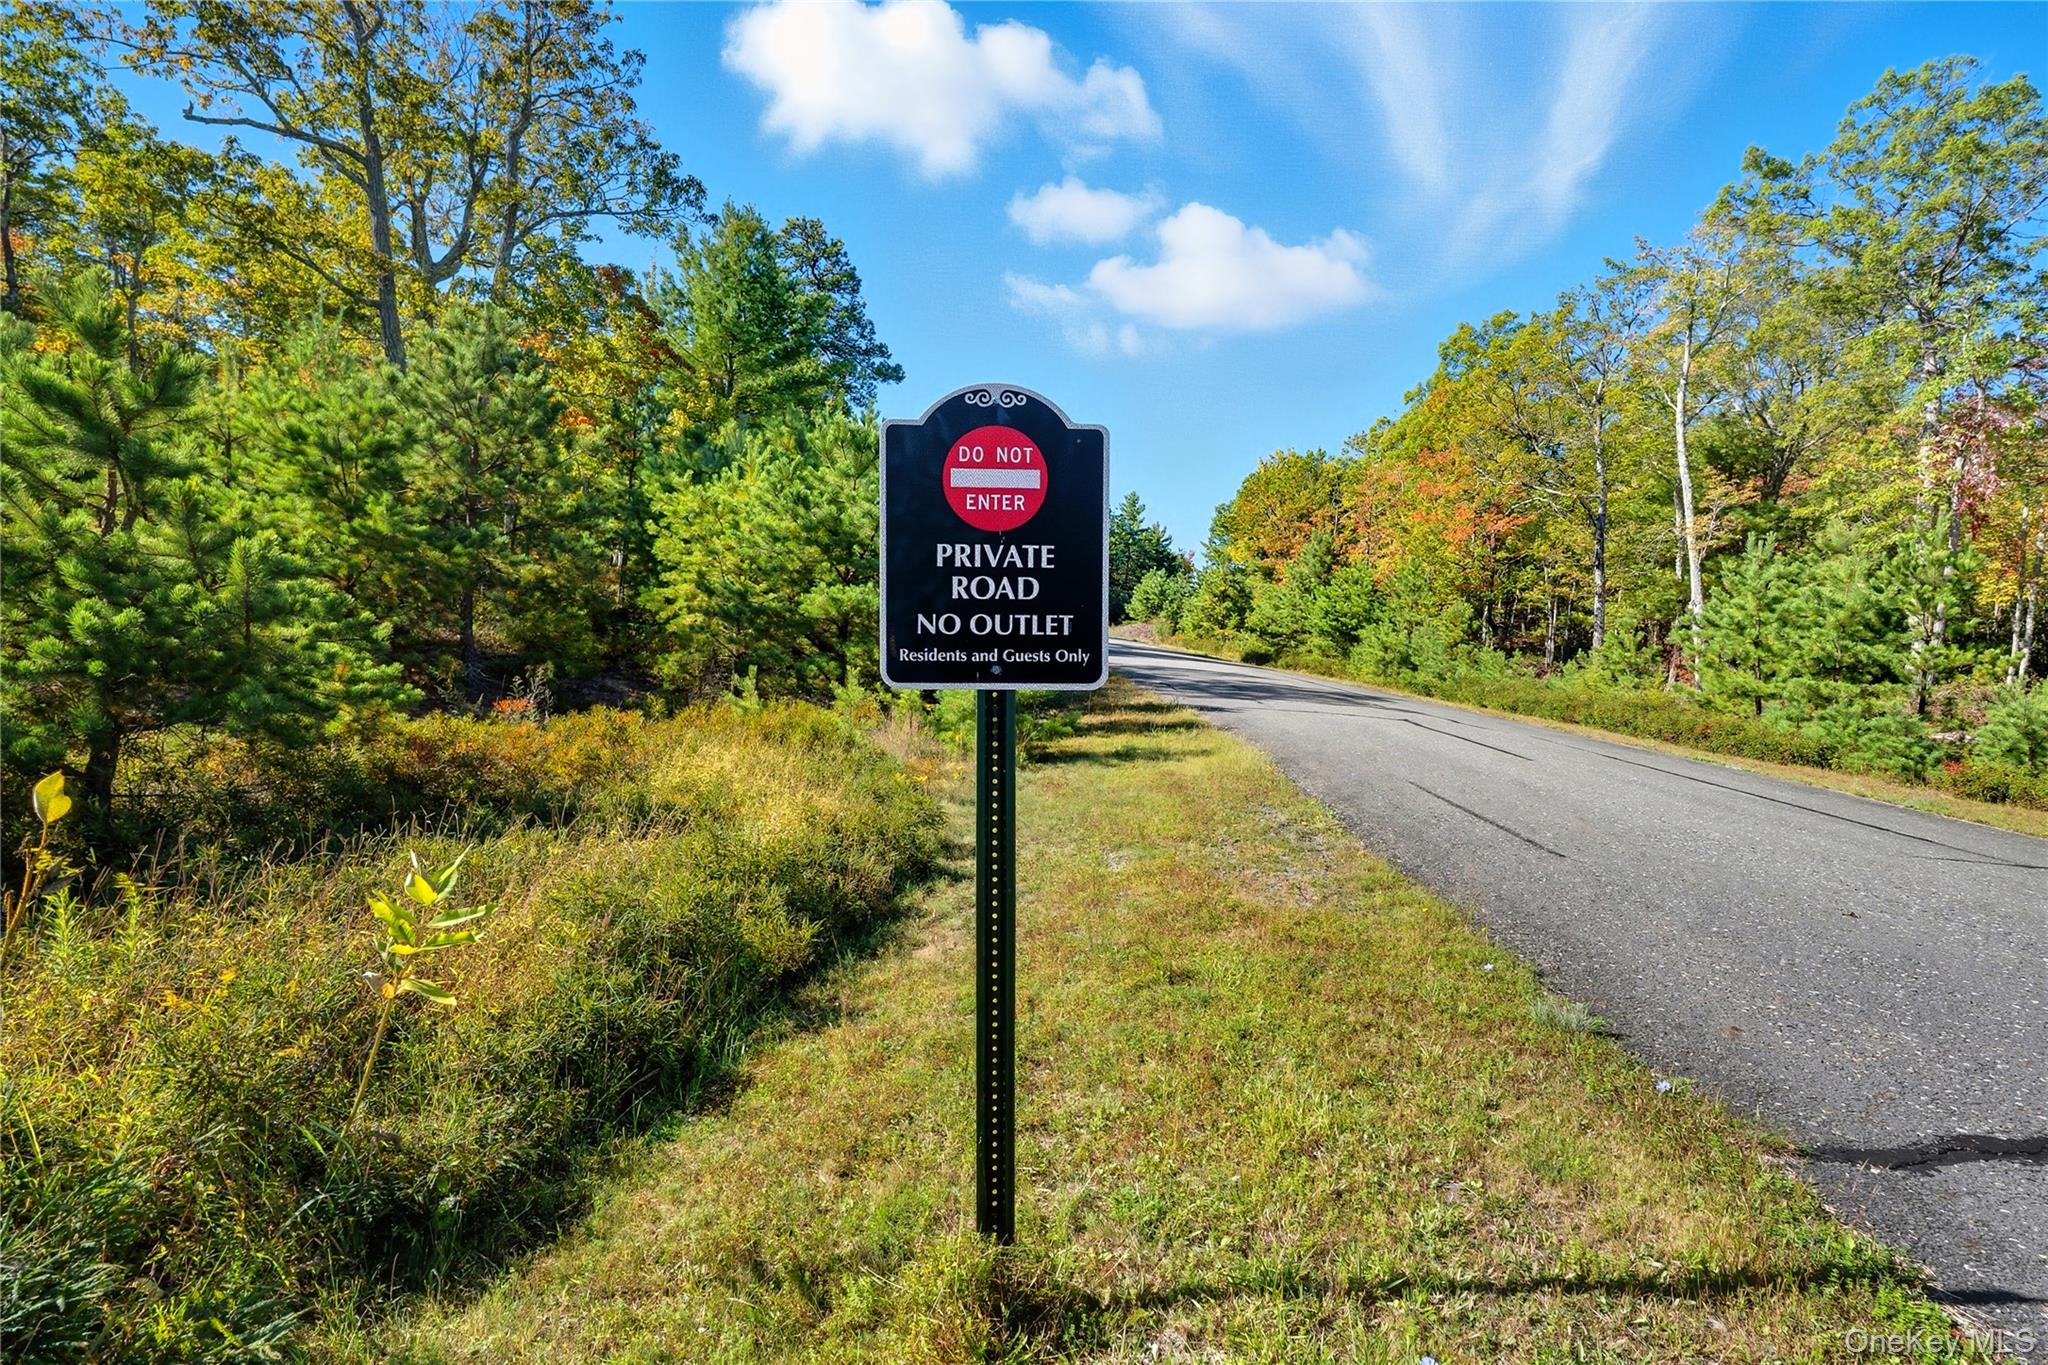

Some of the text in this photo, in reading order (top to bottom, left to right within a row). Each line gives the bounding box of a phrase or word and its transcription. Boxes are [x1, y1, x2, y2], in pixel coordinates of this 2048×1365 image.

[958, 446, 1034, 464] DO NOT
[965, 494, 1026, 511] ENTER
[936, 543, 1056, 569] PRIVATE
[951, 575, 1040, 601] ROAD
[916, 613, 1074, 636] NO OUTLET
[899, 648, 1090, 666] Residents and Guests Only
